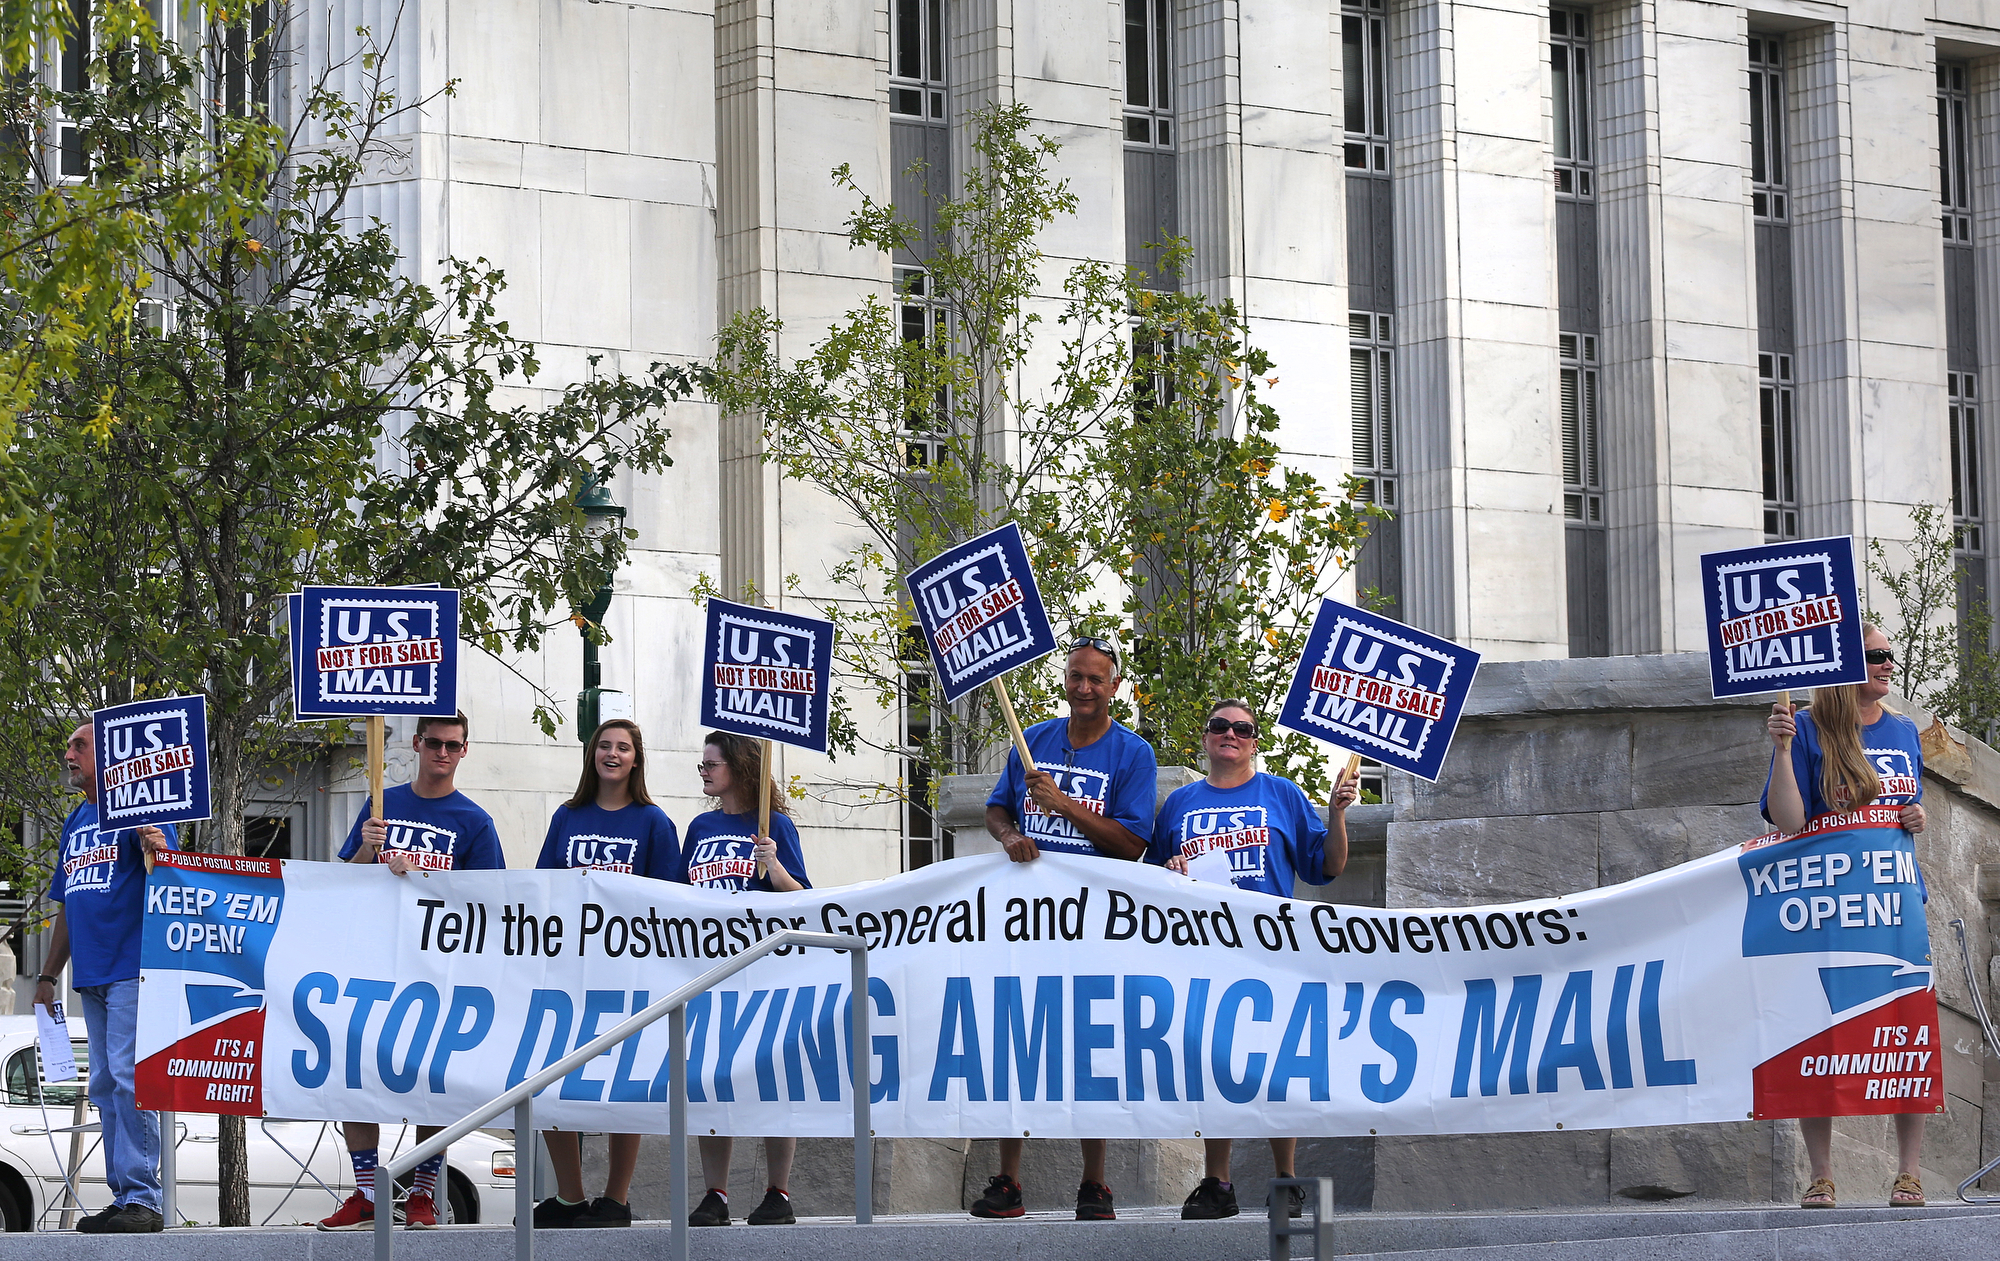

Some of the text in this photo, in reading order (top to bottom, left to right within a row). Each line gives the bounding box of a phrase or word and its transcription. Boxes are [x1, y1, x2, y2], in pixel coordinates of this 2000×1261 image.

[929, 565, 999, 619] U.S.
[1732, 569, 1817, 613] U.S.
[337, 610, 422, 643] U.S.
[935, 582, 1021, 652] NOT FOR SALE
[1722, 599, 1840, 645] NOT FOR SALE
[319, 641, 439, 669] NOT FOR SALE
[730, 627, 800, 669] U.S.
[951, 620, 1019, 671] MAIL
[1342, 633, 1428, 691] U.S.
[1740, 635, 1825, 669] MAIL
[335, 669, 422, 694] MAIL
[716, 666, 814, 692] NOT FOR SALE
[1314, 668, 1441, 717] NOT FOR SALE
[727, 688, 800, 724] MAIL
[1320, 695, 1410, 746] MAIL
[113, 723, 174, 760] U.S.
[105, 747, 192, 789] NOT FOR SALE
[114, 778, 179, 809] MAIL
[1888, 778, 1916, 794] SALE
[389, 826, 442, 853] U.S.
[1192, 812, 1255, 835] U.S.
[1756, 833, 1777, 848] THE
[1822, 811, 1867, 829] POSTAL
[80, 853, 92, 867] OR
[92, 846, 117, 863] SALE
[577, 841, 622, 866] U.S.
[696, 841, 744, 864] U.S.
[1181, 828, 1267, 859] NOT FOR SALE
[155, 850, 271, 874] THE PUBLIC POSTAL SERVICE
[423, 854, 450, 871] SALE
[690, 860, 754, 882] OT FOR SALE
[1748, 850, 1917, 897] KEEP 'EM
[147, 884, 280, 924] KEEP 'EM
[1779, 892, 1902, 932] OPEN!
[166, 921, 246, 954] OPEN!
[417, 899, 487, 954] Tell
[501, 903, 563, 957] the
[820, 886, 986, 954] General
[1005, 887, 1088, 942] and
[1104, 889, 1243, 949] Board
[1253, 903, 1300, 951] of
[1310, 904, 1588, 954] Governors:
[213, 1039, 255, 1058] IT'S A
[291, 959, 1697, 1105] STOP DELAYING AMERICA'S MAIL
[1872, 1025, 1929, 1047] IT'S A
[167, 1058, 255, 1081] COMMUNITY
[1800, 1051, 1932, 1077] COMMUNITY
[205, 1083, 255, 1103] RIGHT!
[1864, 1077, 1932, 1100] RIGHT!
